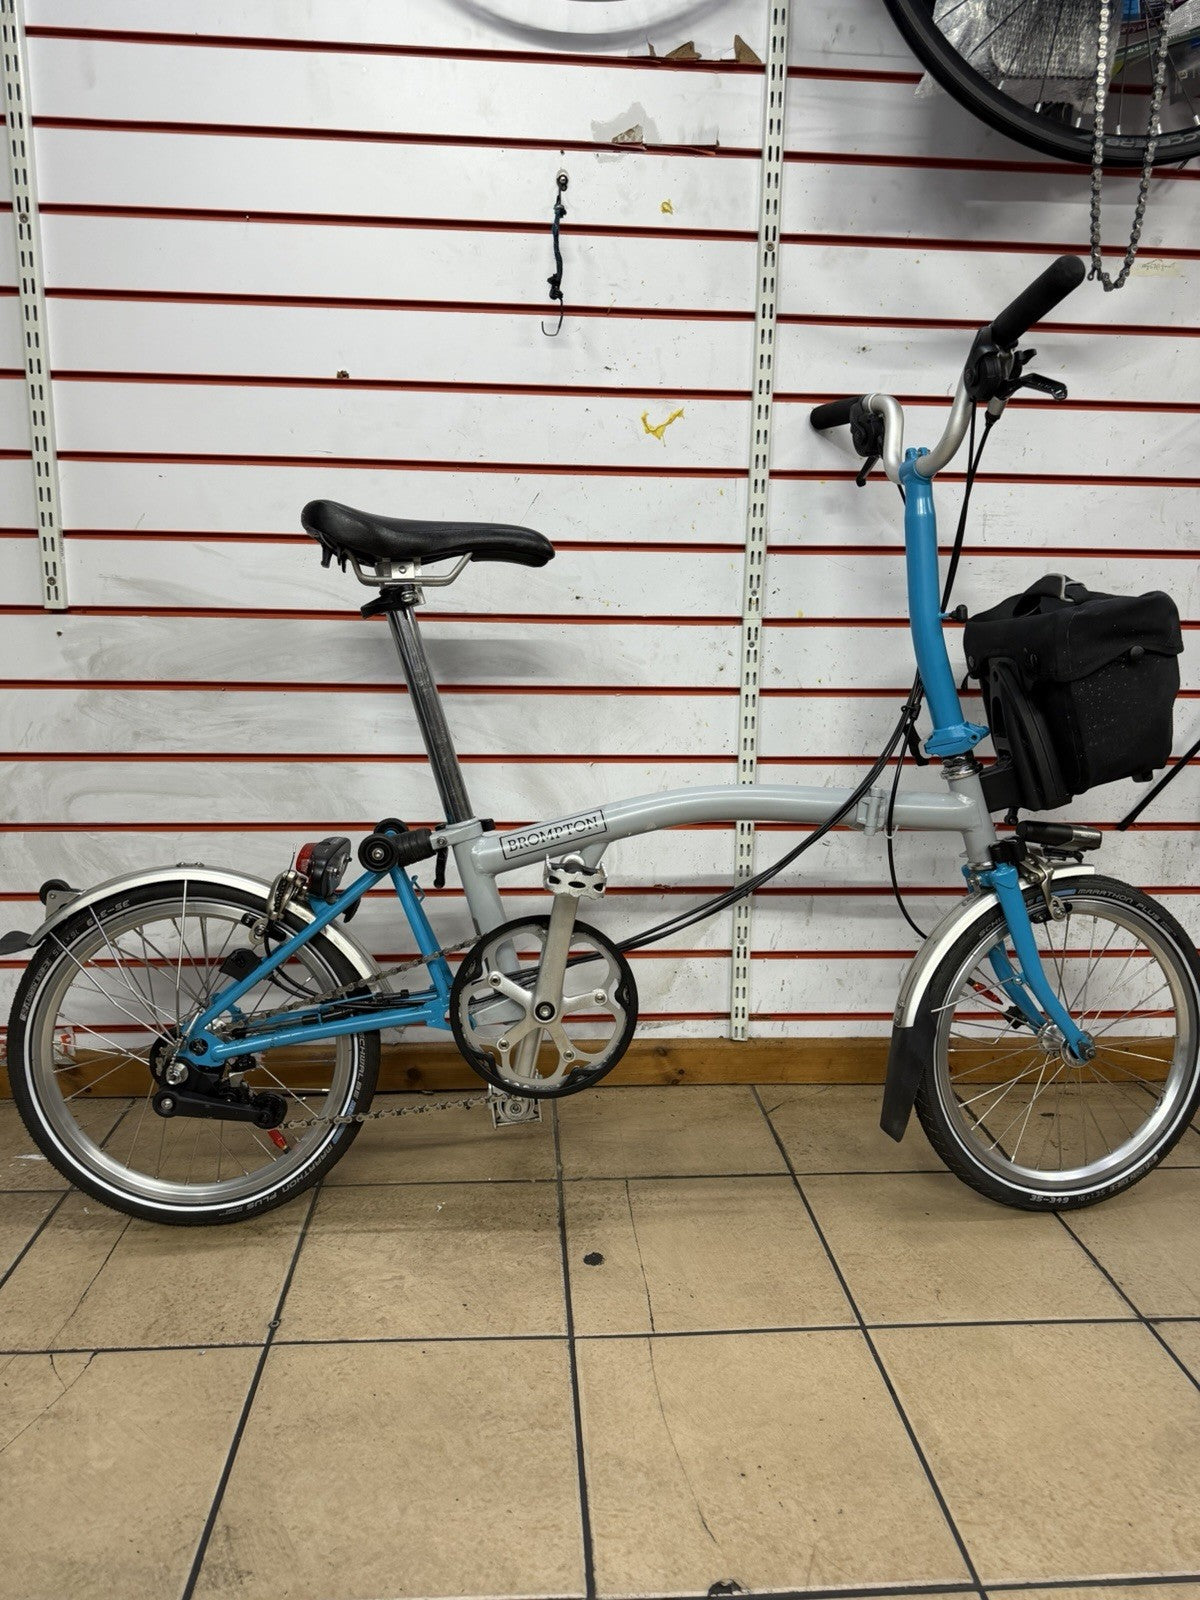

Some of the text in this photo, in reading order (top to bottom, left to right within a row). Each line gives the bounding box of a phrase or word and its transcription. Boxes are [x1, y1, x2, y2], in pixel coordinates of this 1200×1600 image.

[507, 816, 599, 852] BROMPTON
[86, 900, 129, 926] 35-39
[1077, 888, 1160, 921] MARATHON PLUS
[246, 1144, 333, 1210] MARATHON PLUS
[1029, 1194, 1069, 1204] 35-349
